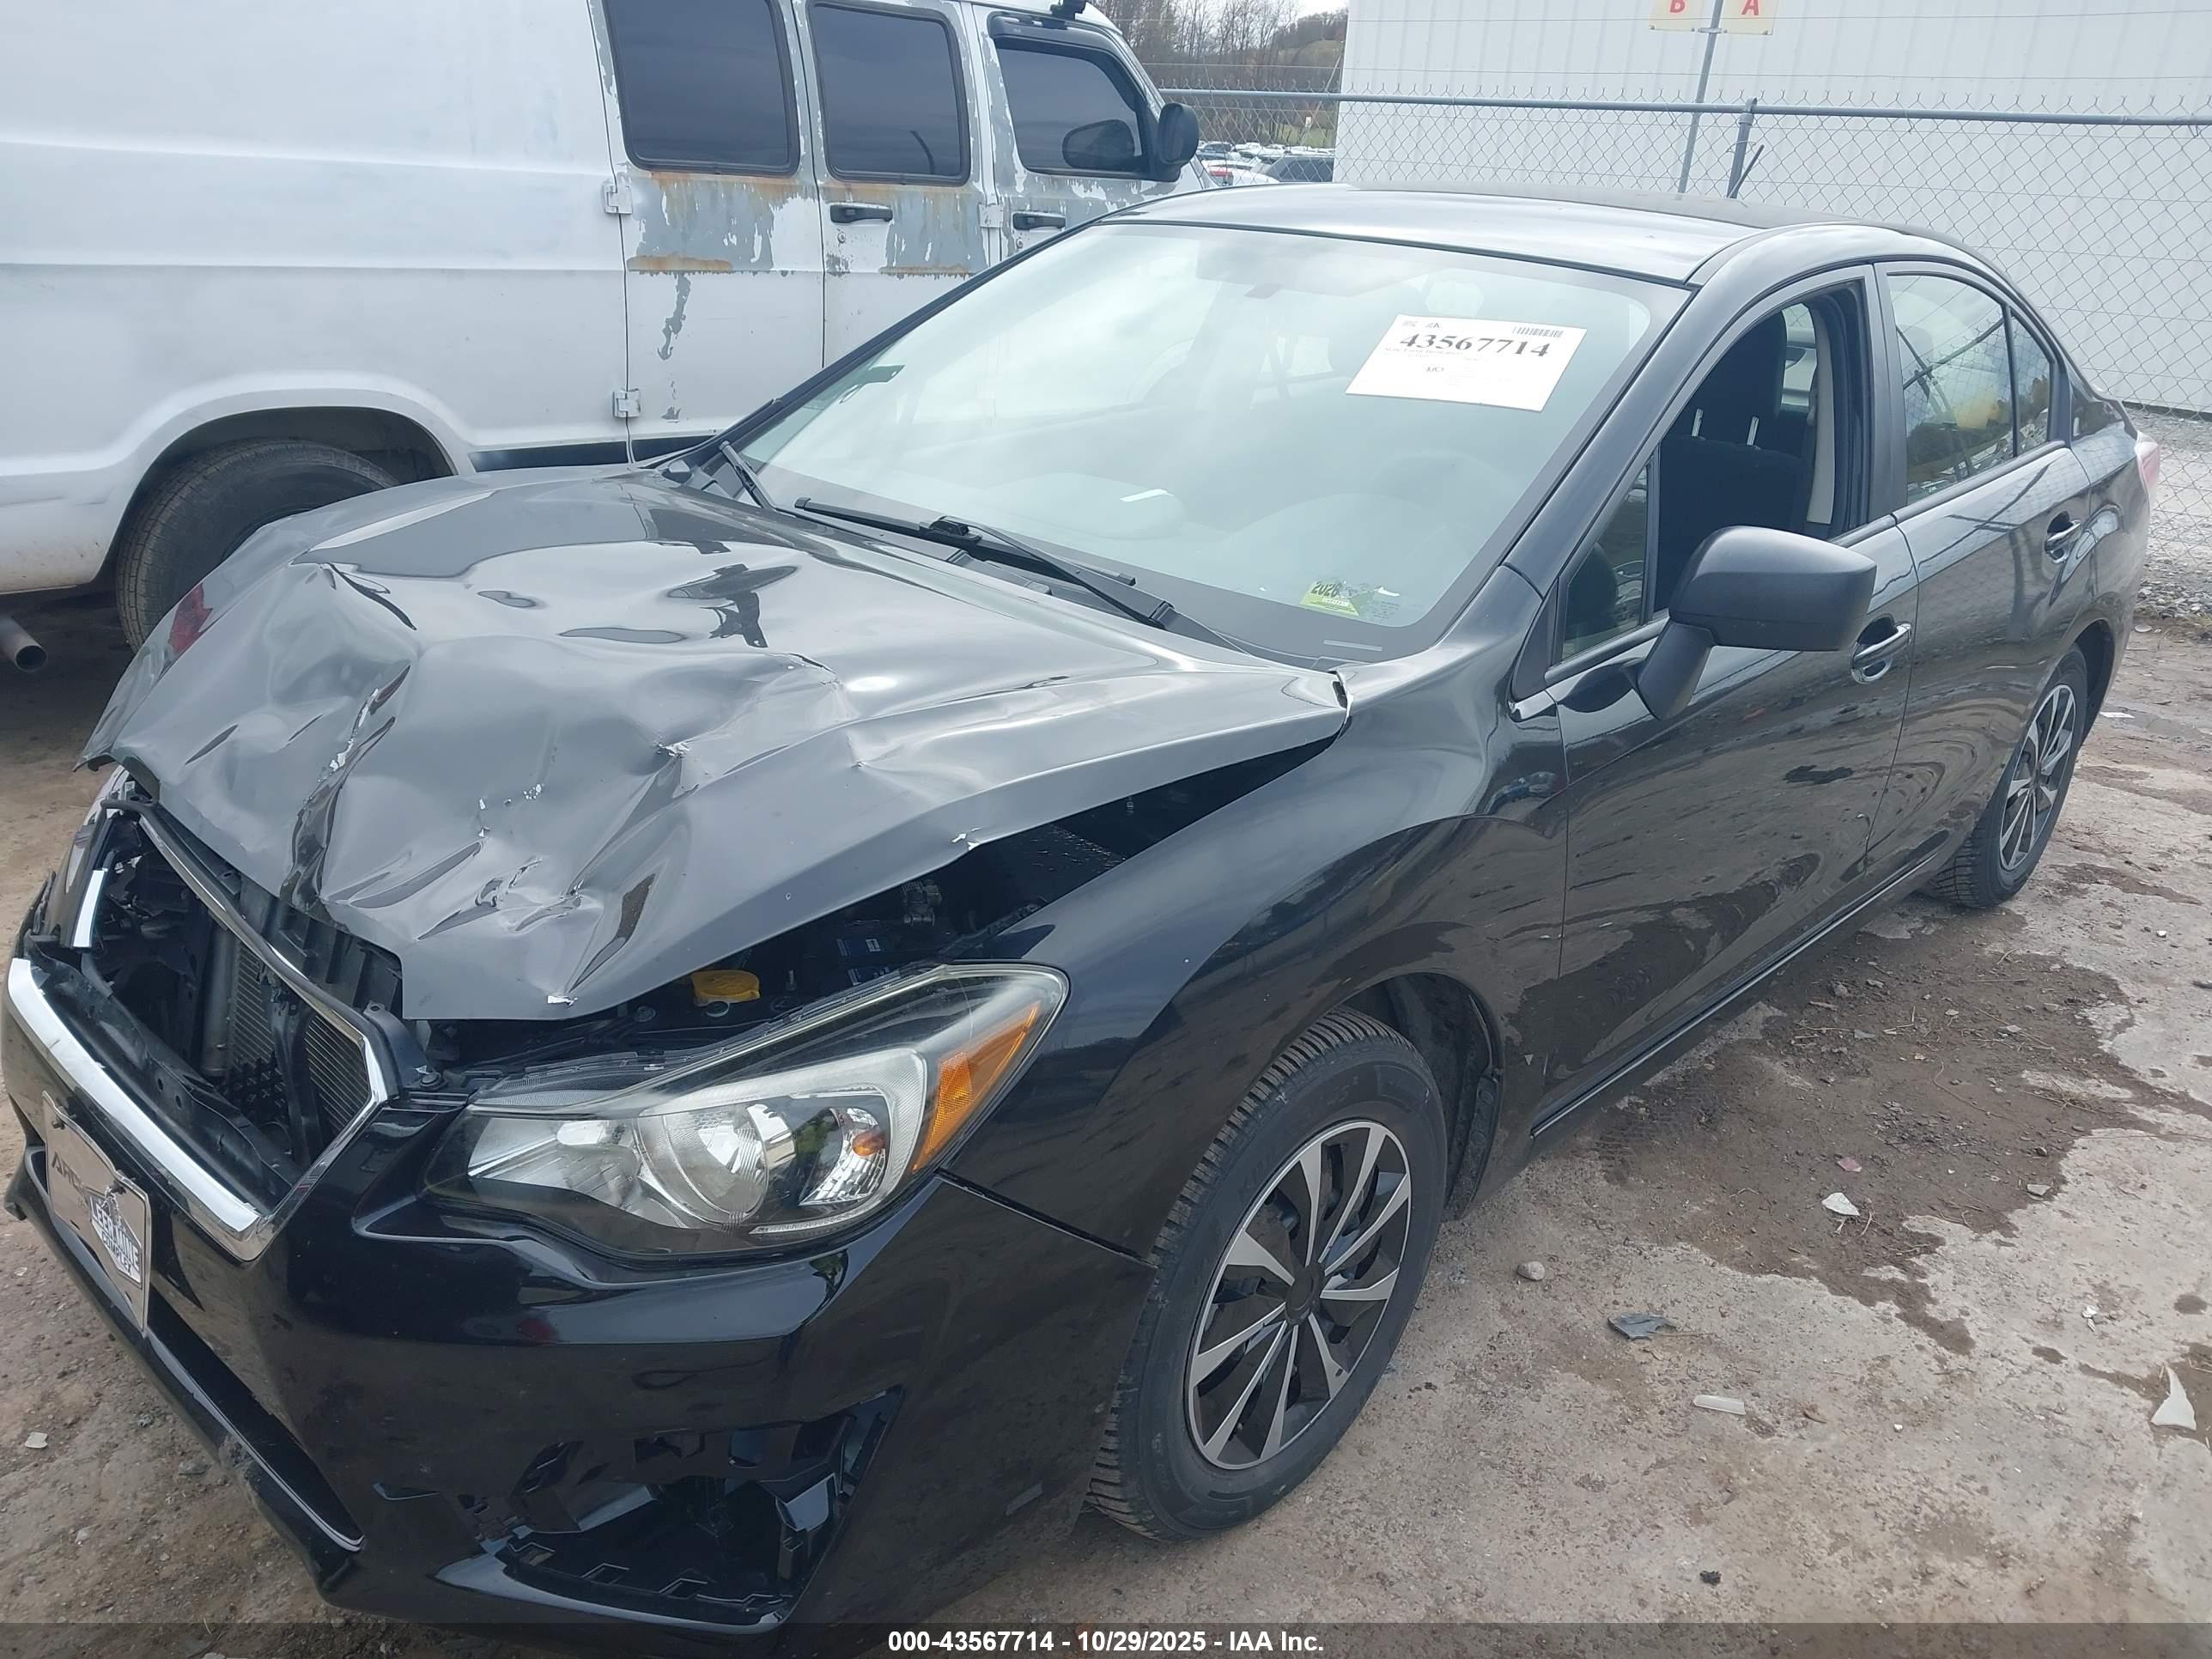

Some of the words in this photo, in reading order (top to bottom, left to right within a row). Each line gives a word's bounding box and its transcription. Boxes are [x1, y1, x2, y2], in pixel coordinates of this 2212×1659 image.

[1399, 333, 1552, 357] 43567714
[102, 1230, 131, 1274] COMPLEX
[115, 1224, 139, 1272] MINE
